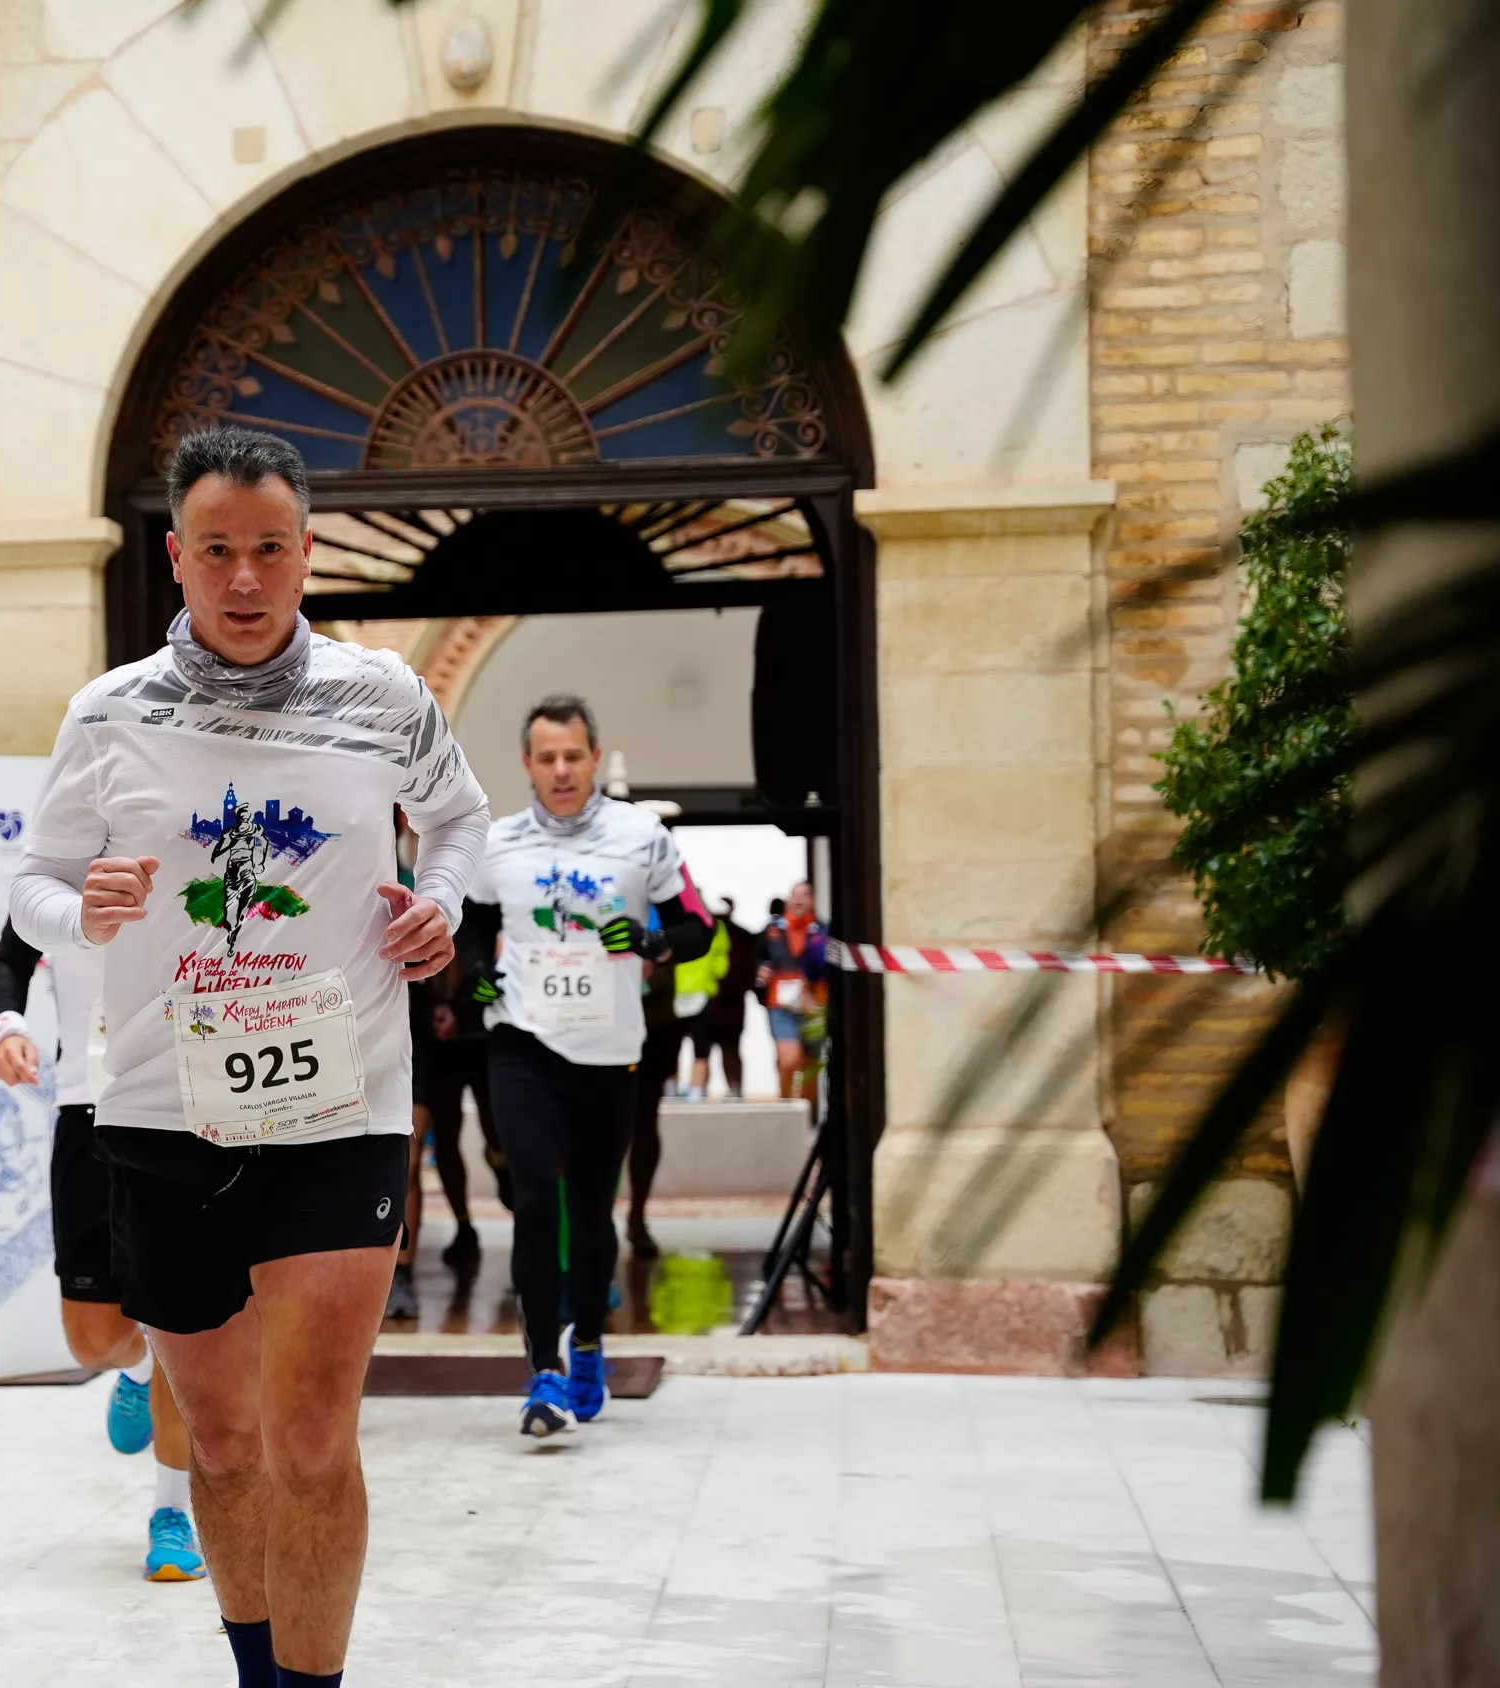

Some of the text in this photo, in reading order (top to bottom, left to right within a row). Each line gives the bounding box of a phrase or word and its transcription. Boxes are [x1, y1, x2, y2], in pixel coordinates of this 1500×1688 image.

[231, 950, 307, 971] MARATÓN
[543, 974, 592, 997] 616
[266, 995, 308, 1013] MARATÓN
[245, 1013, 300, 1033] LUCENA
[224, 1039, 320, 1093] 925
[239, 1092, 318, 1111] CARLOS VARGAS VILLALBA
